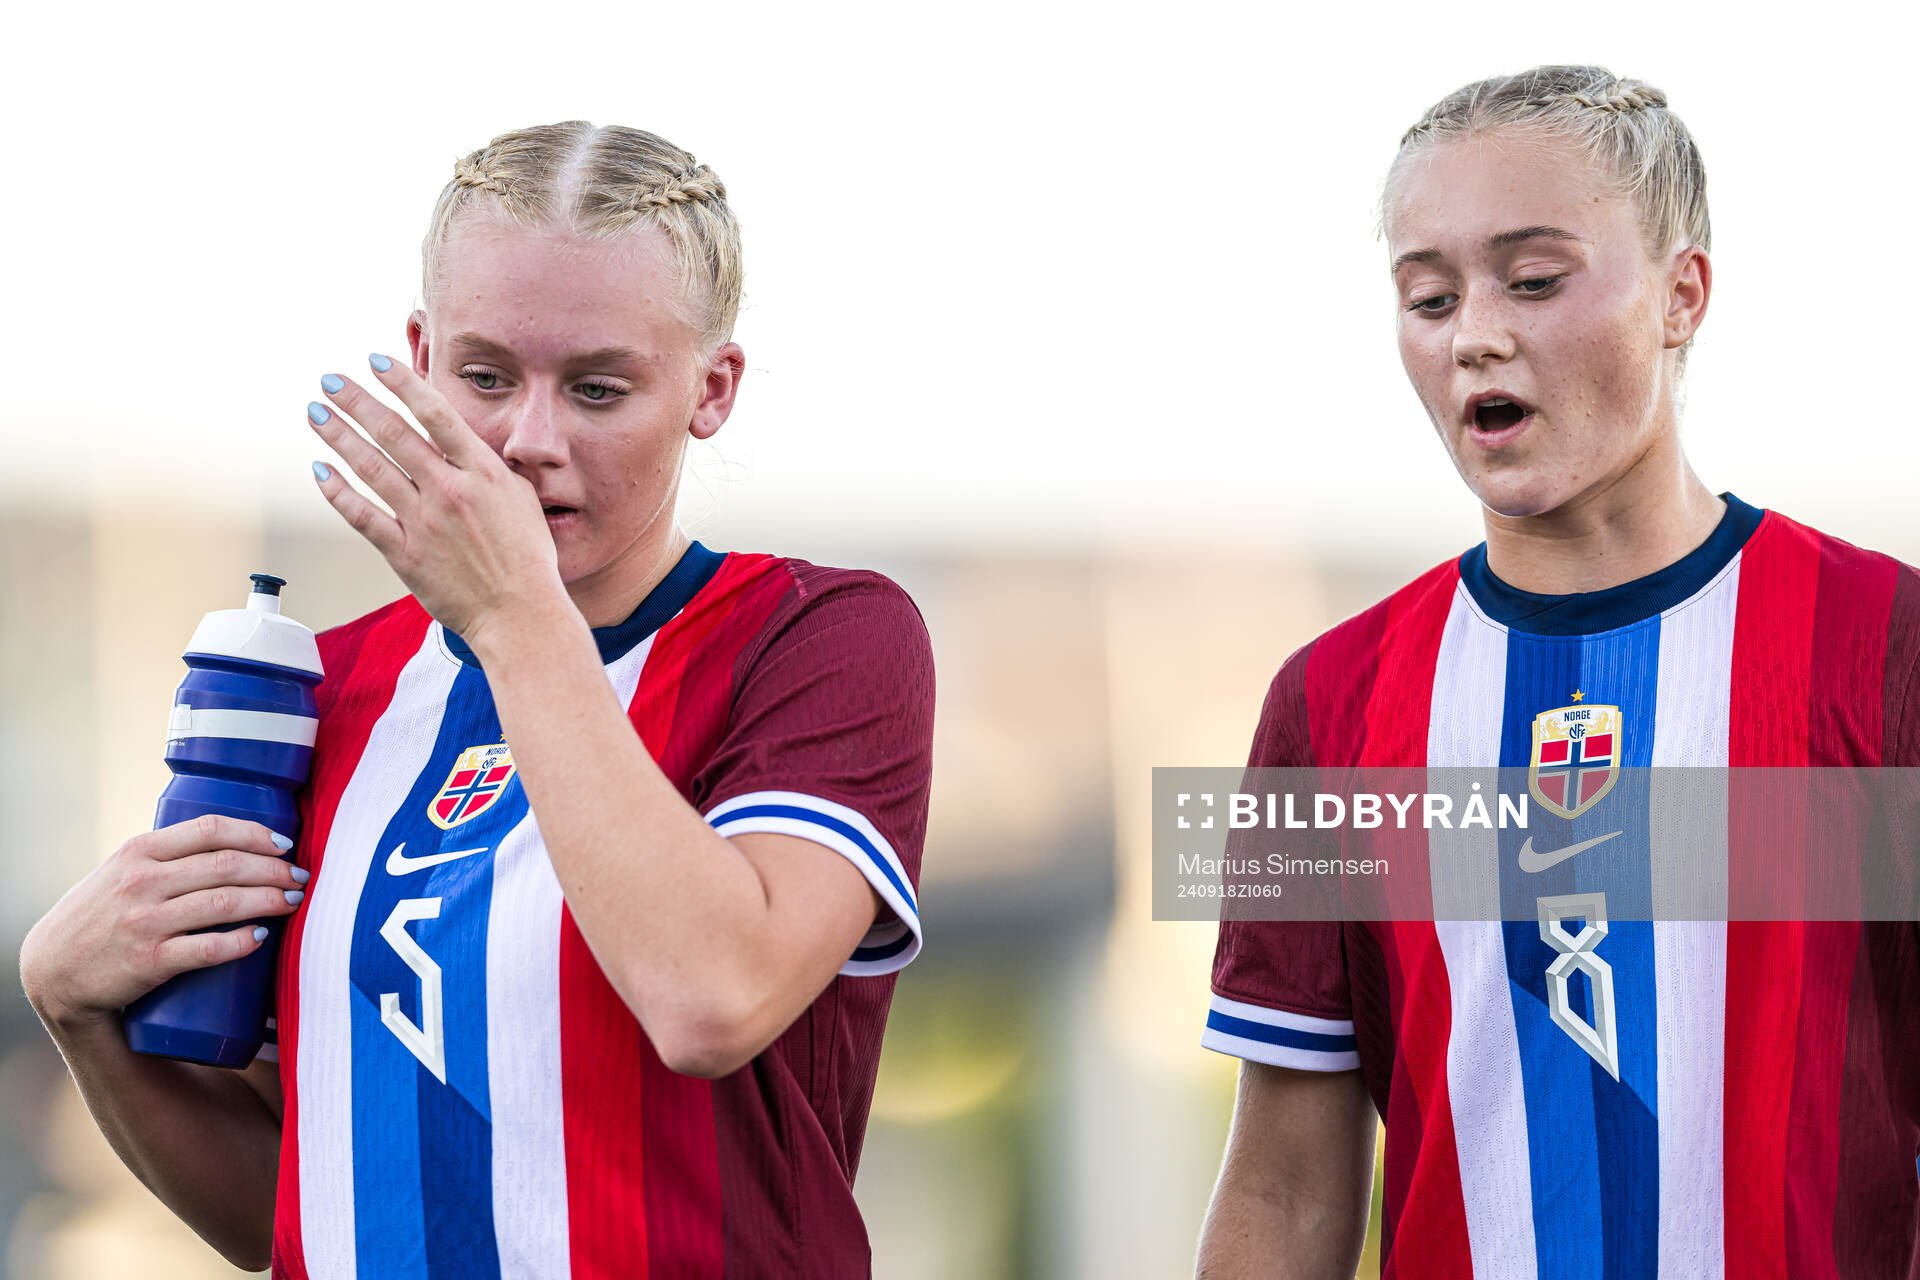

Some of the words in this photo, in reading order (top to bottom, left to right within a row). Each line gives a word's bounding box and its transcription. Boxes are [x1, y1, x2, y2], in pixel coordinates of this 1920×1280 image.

[1564, 710, 1591, 721] NORGE
[379, 896, 446, 1085] 5
[1536, 891, 1620, 1083] 8
